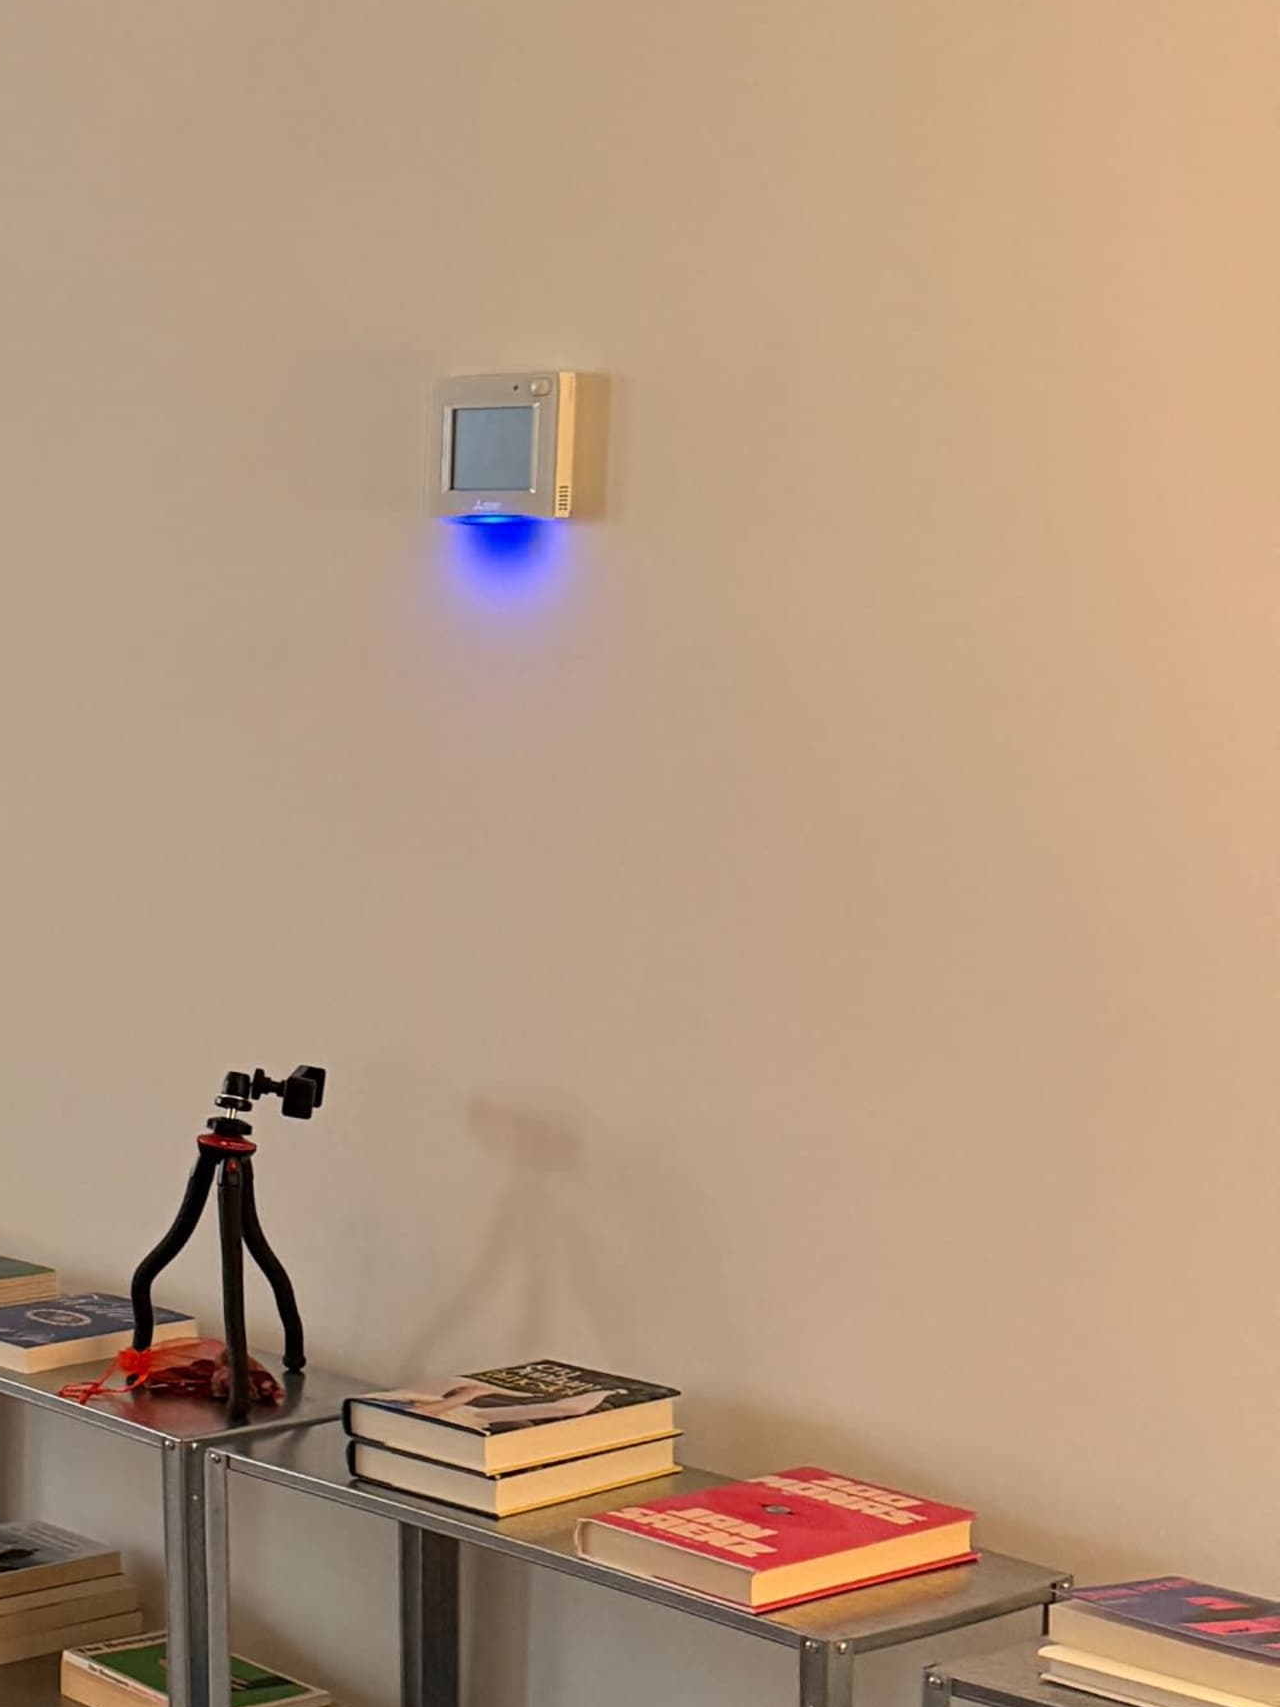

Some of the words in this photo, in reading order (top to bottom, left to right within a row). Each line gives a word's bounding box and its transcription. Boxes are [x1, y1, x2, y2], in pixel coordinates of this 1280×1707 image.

[666, 1506, 781, 1539] JAN
[744, 1474, 929, 1526] MONAS
[606, 1506, 776, 1557] SAENZ
